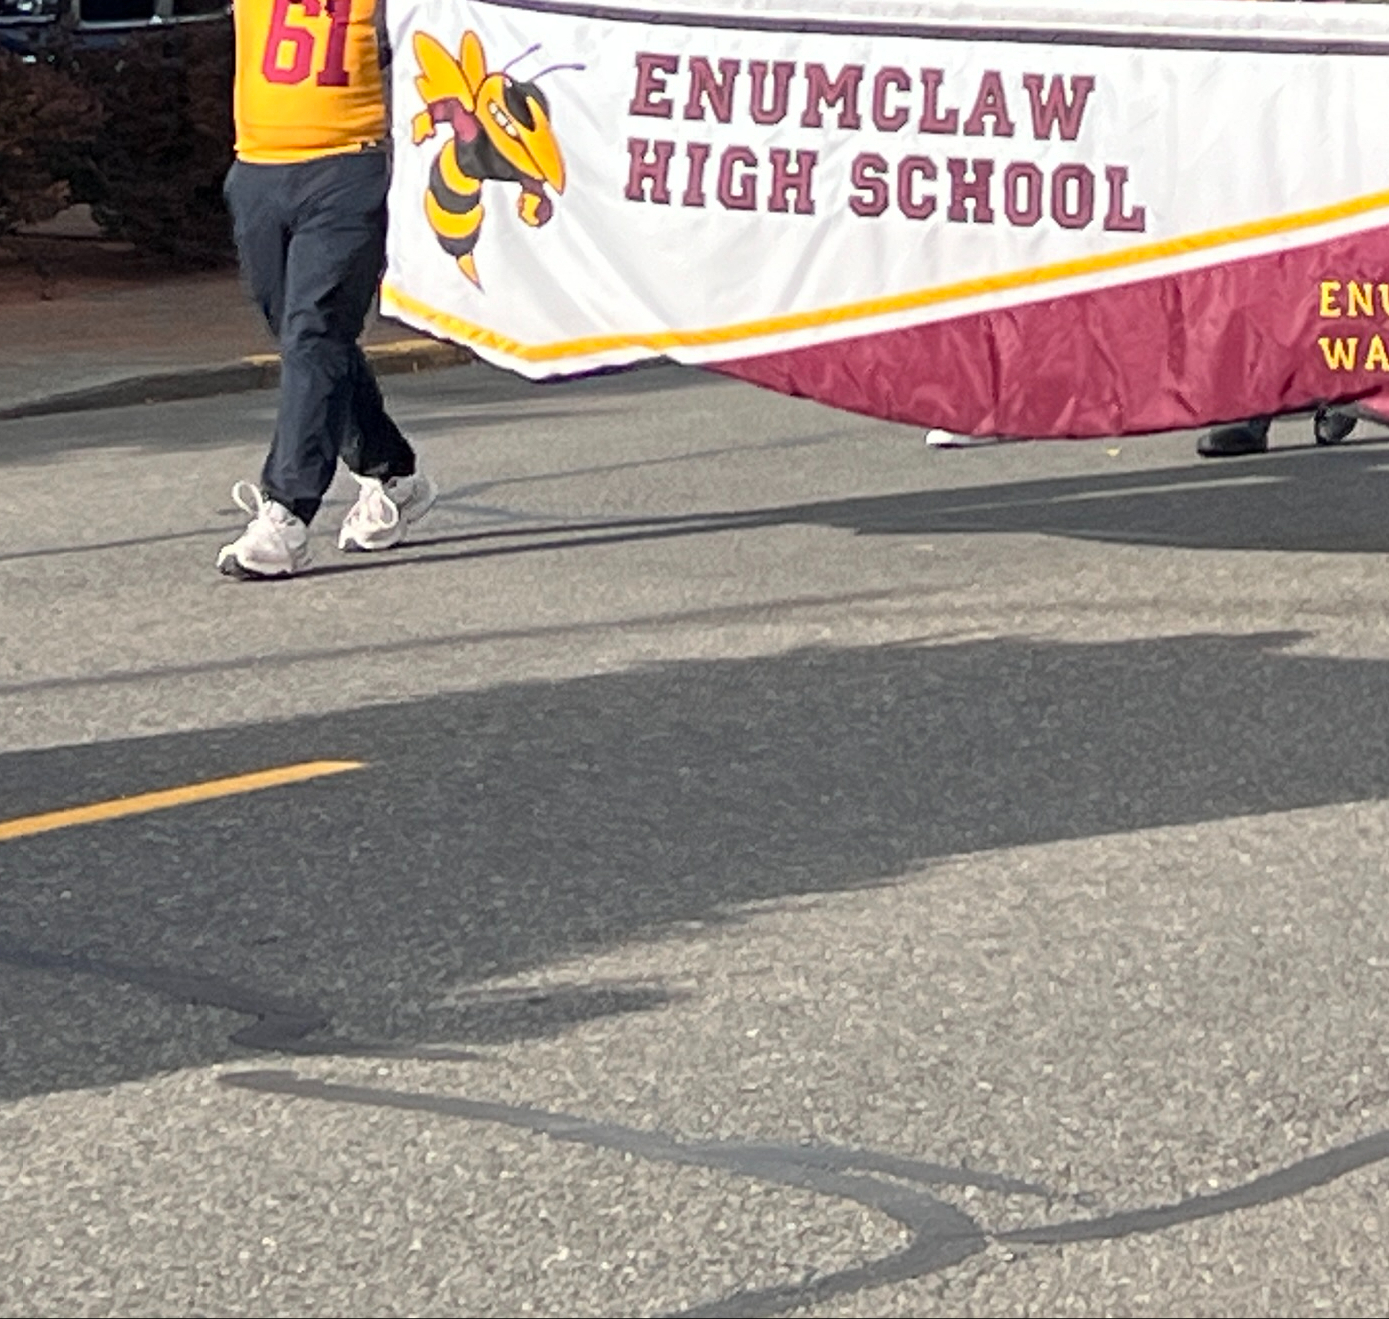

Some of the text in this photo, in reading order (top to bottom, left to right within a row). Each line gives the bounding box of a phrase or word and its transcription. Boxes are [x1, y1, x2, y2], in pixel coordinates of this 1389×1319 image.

[628, 50, 1096, 142] ENUMCLAW
[624, 137, 1147, 233] HIGH SCHOOL
